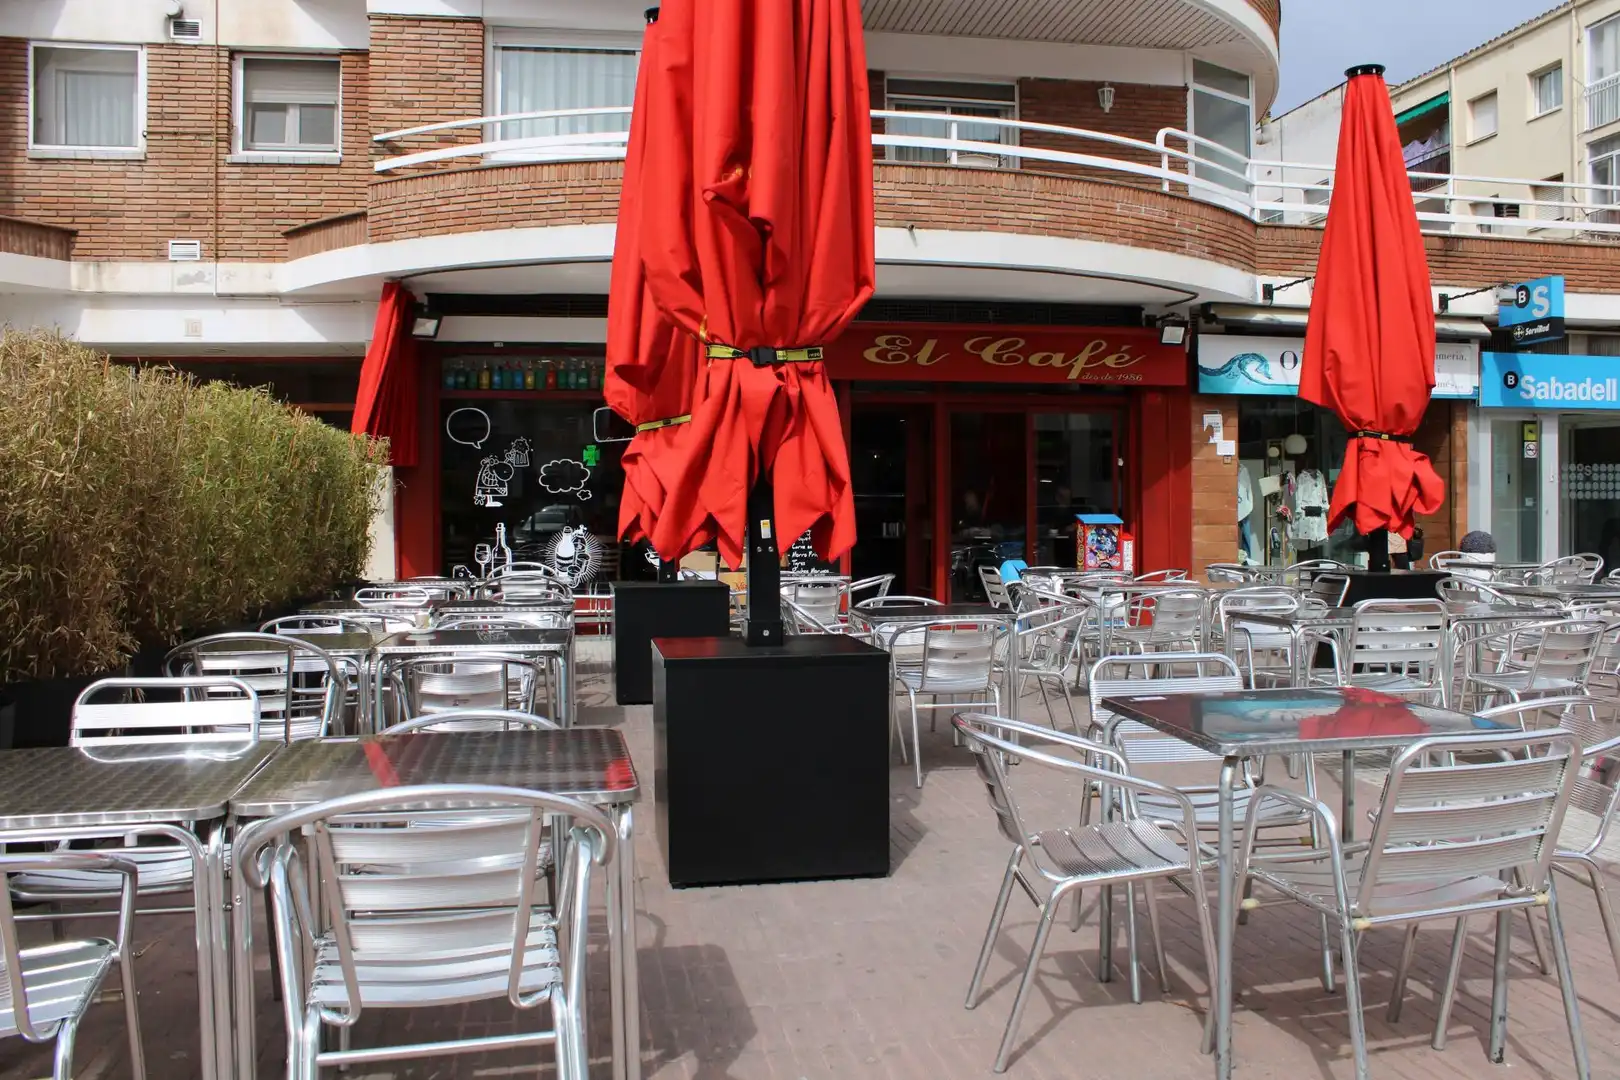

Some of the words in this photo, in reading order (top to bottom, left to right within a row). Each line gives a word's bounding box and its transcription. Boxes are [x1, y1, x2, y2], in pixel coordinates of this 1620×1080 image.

[1531, 285, 1549, 318] S
[863, 334, 949, 365] El
[963, 335, 1146, 380] Café
[1116, 373, 1144, 382] 1986
[1519, 374, 1617, 402] Sabadell
